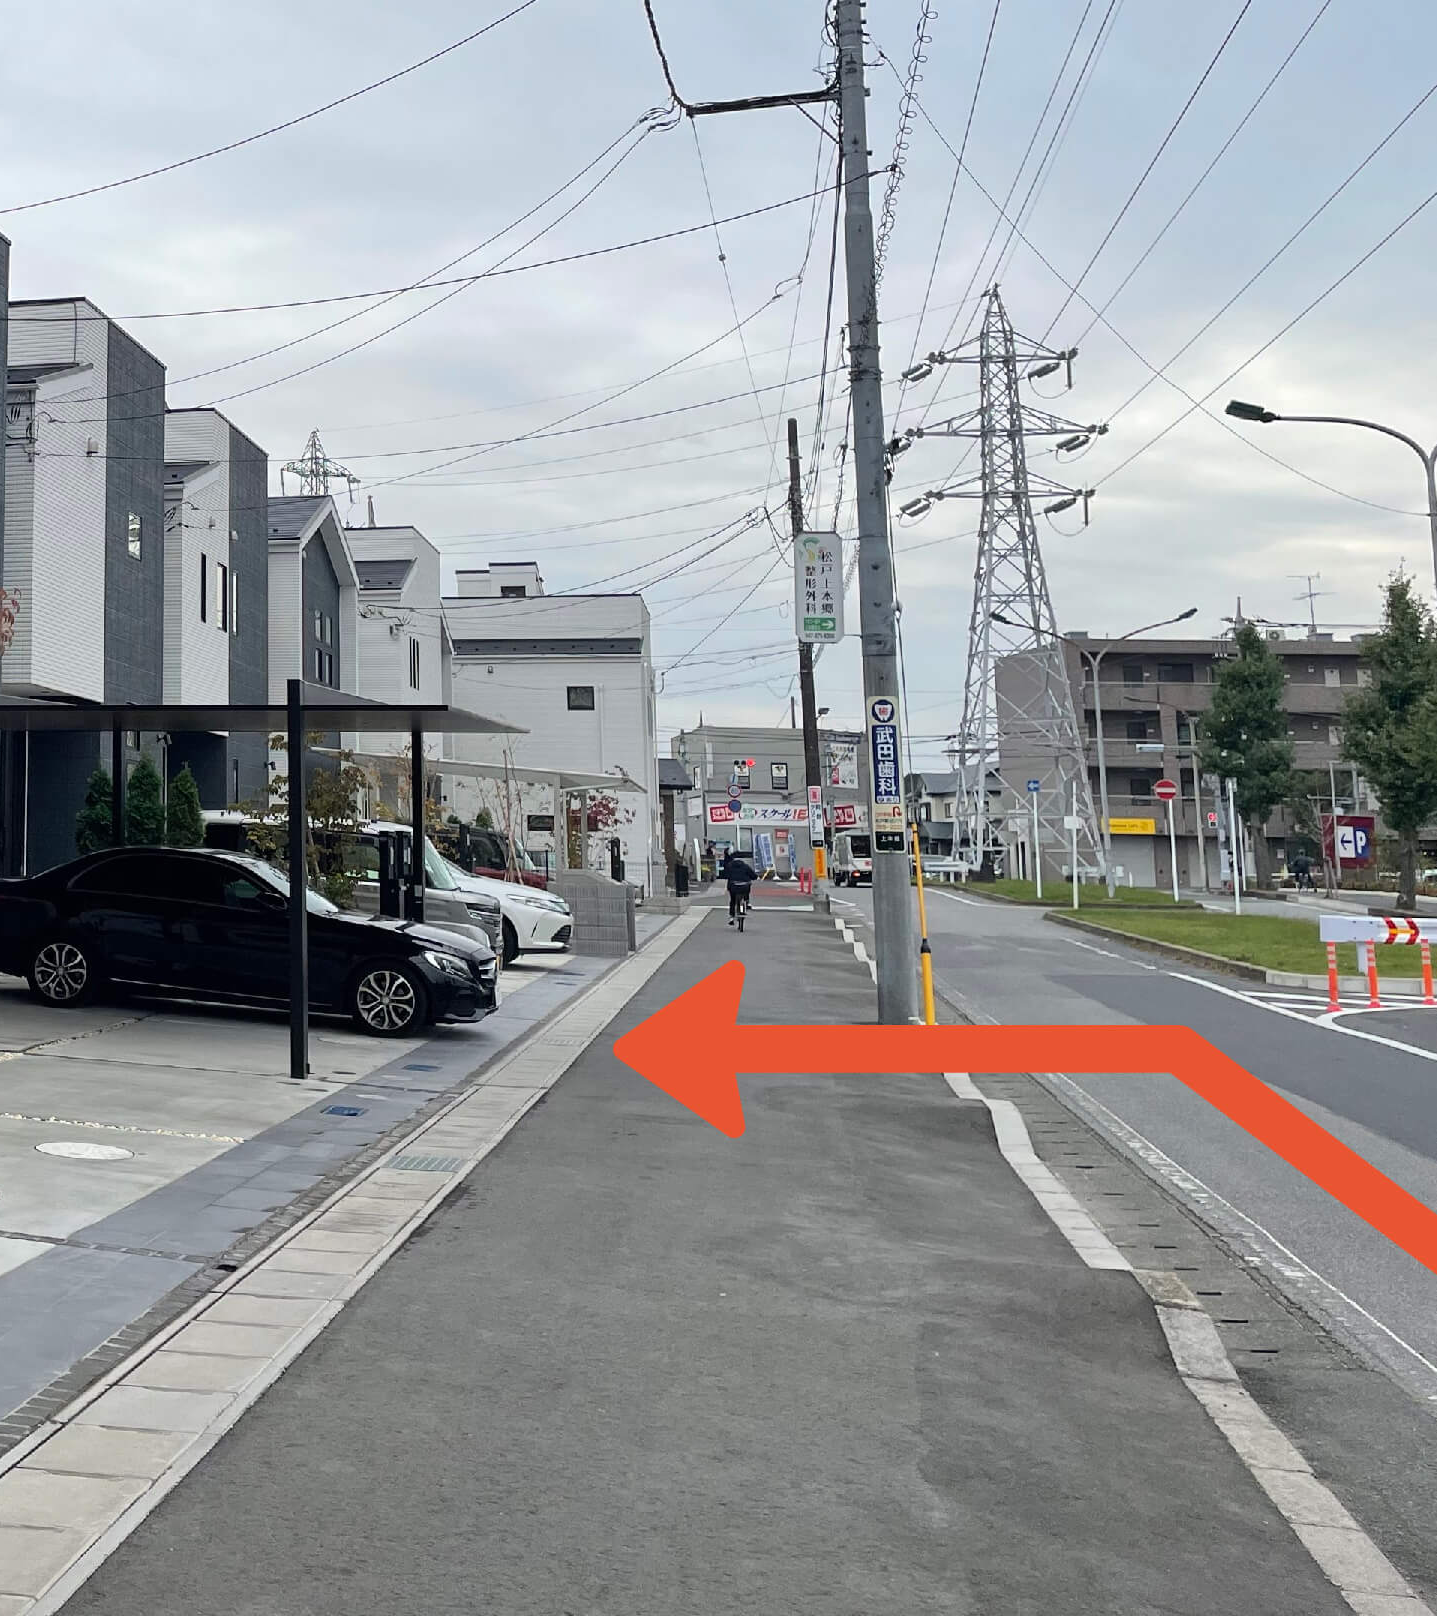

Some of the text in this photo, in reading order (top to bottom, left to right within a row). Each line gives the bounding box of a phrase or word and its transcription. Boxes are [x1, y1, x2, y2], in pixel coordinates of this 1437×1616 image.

[805, 565, 817, 615] 整形外科
[821, 551, 834, 615] 松戸上本郷
[875, 726, 897, 796] 武田歯科
[1355, 830, 1367, 855] P
